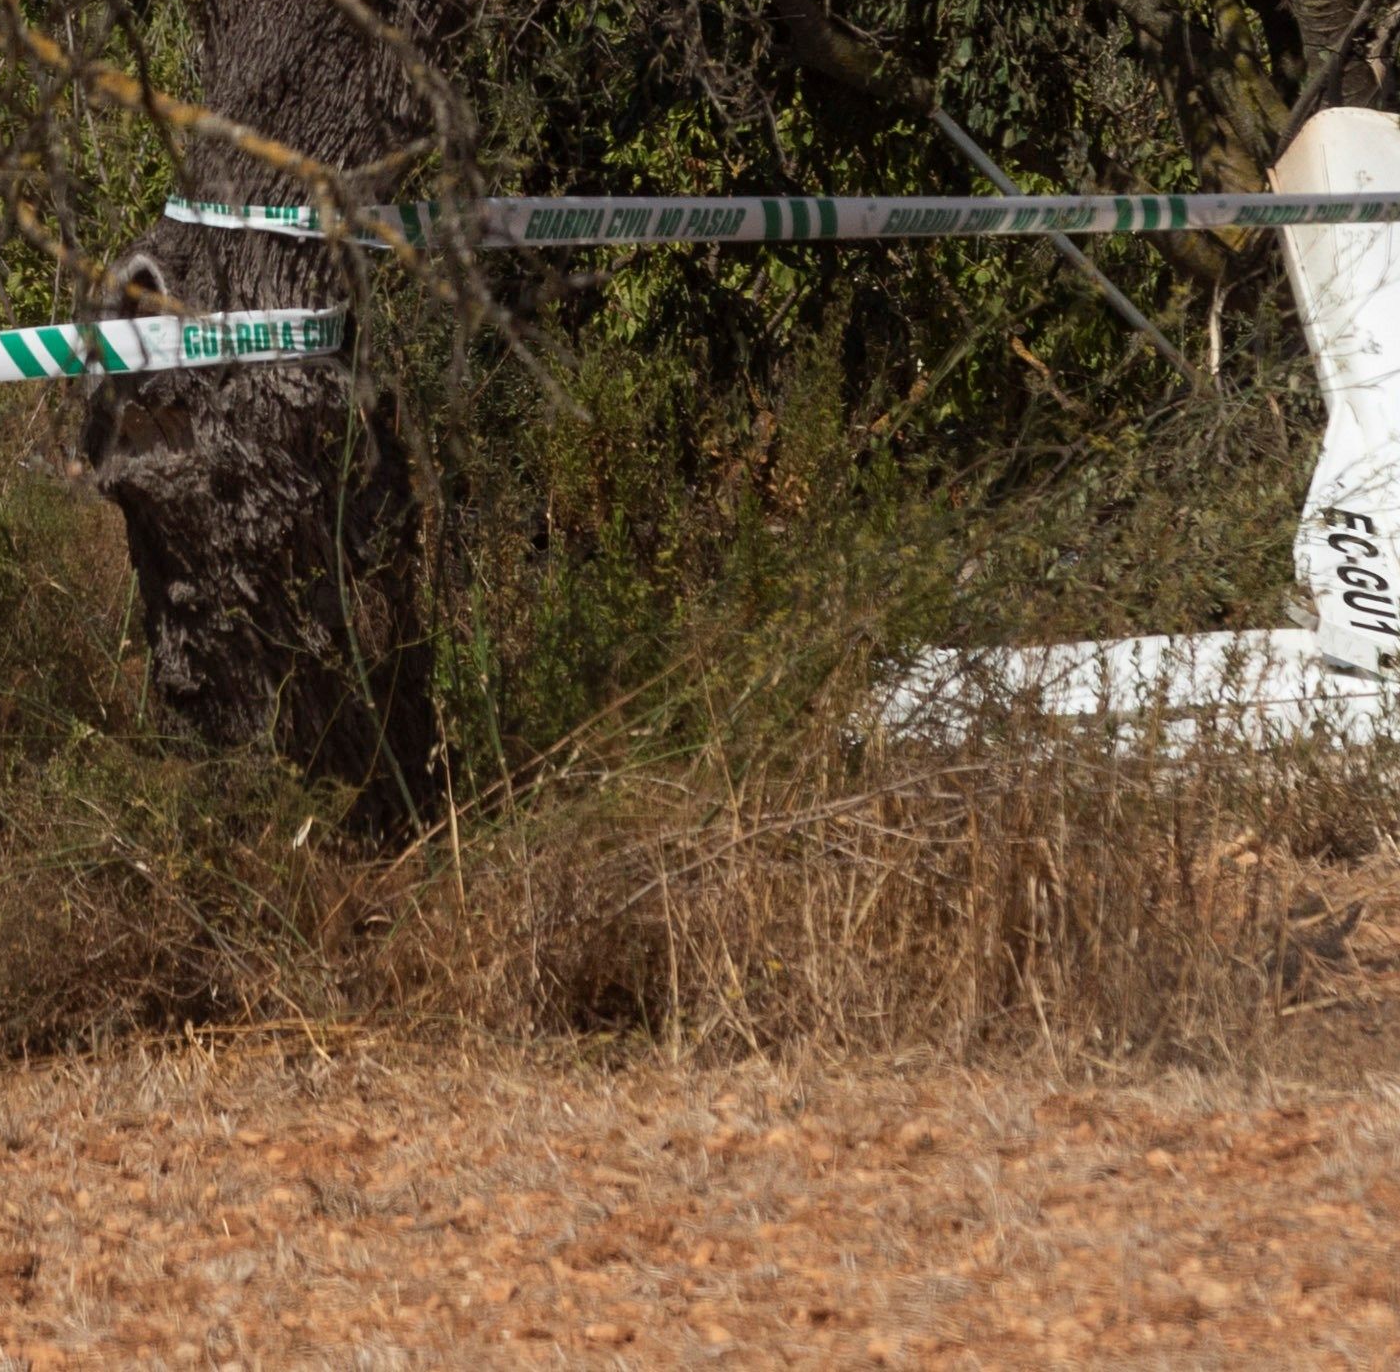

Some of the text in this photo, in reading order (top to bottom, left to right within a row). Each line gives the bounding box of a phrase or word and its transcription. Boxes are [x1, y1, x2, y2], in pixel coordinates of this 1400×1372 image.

[523, 206, 748, 240] GUARDIA CIVIL NO PASAR
